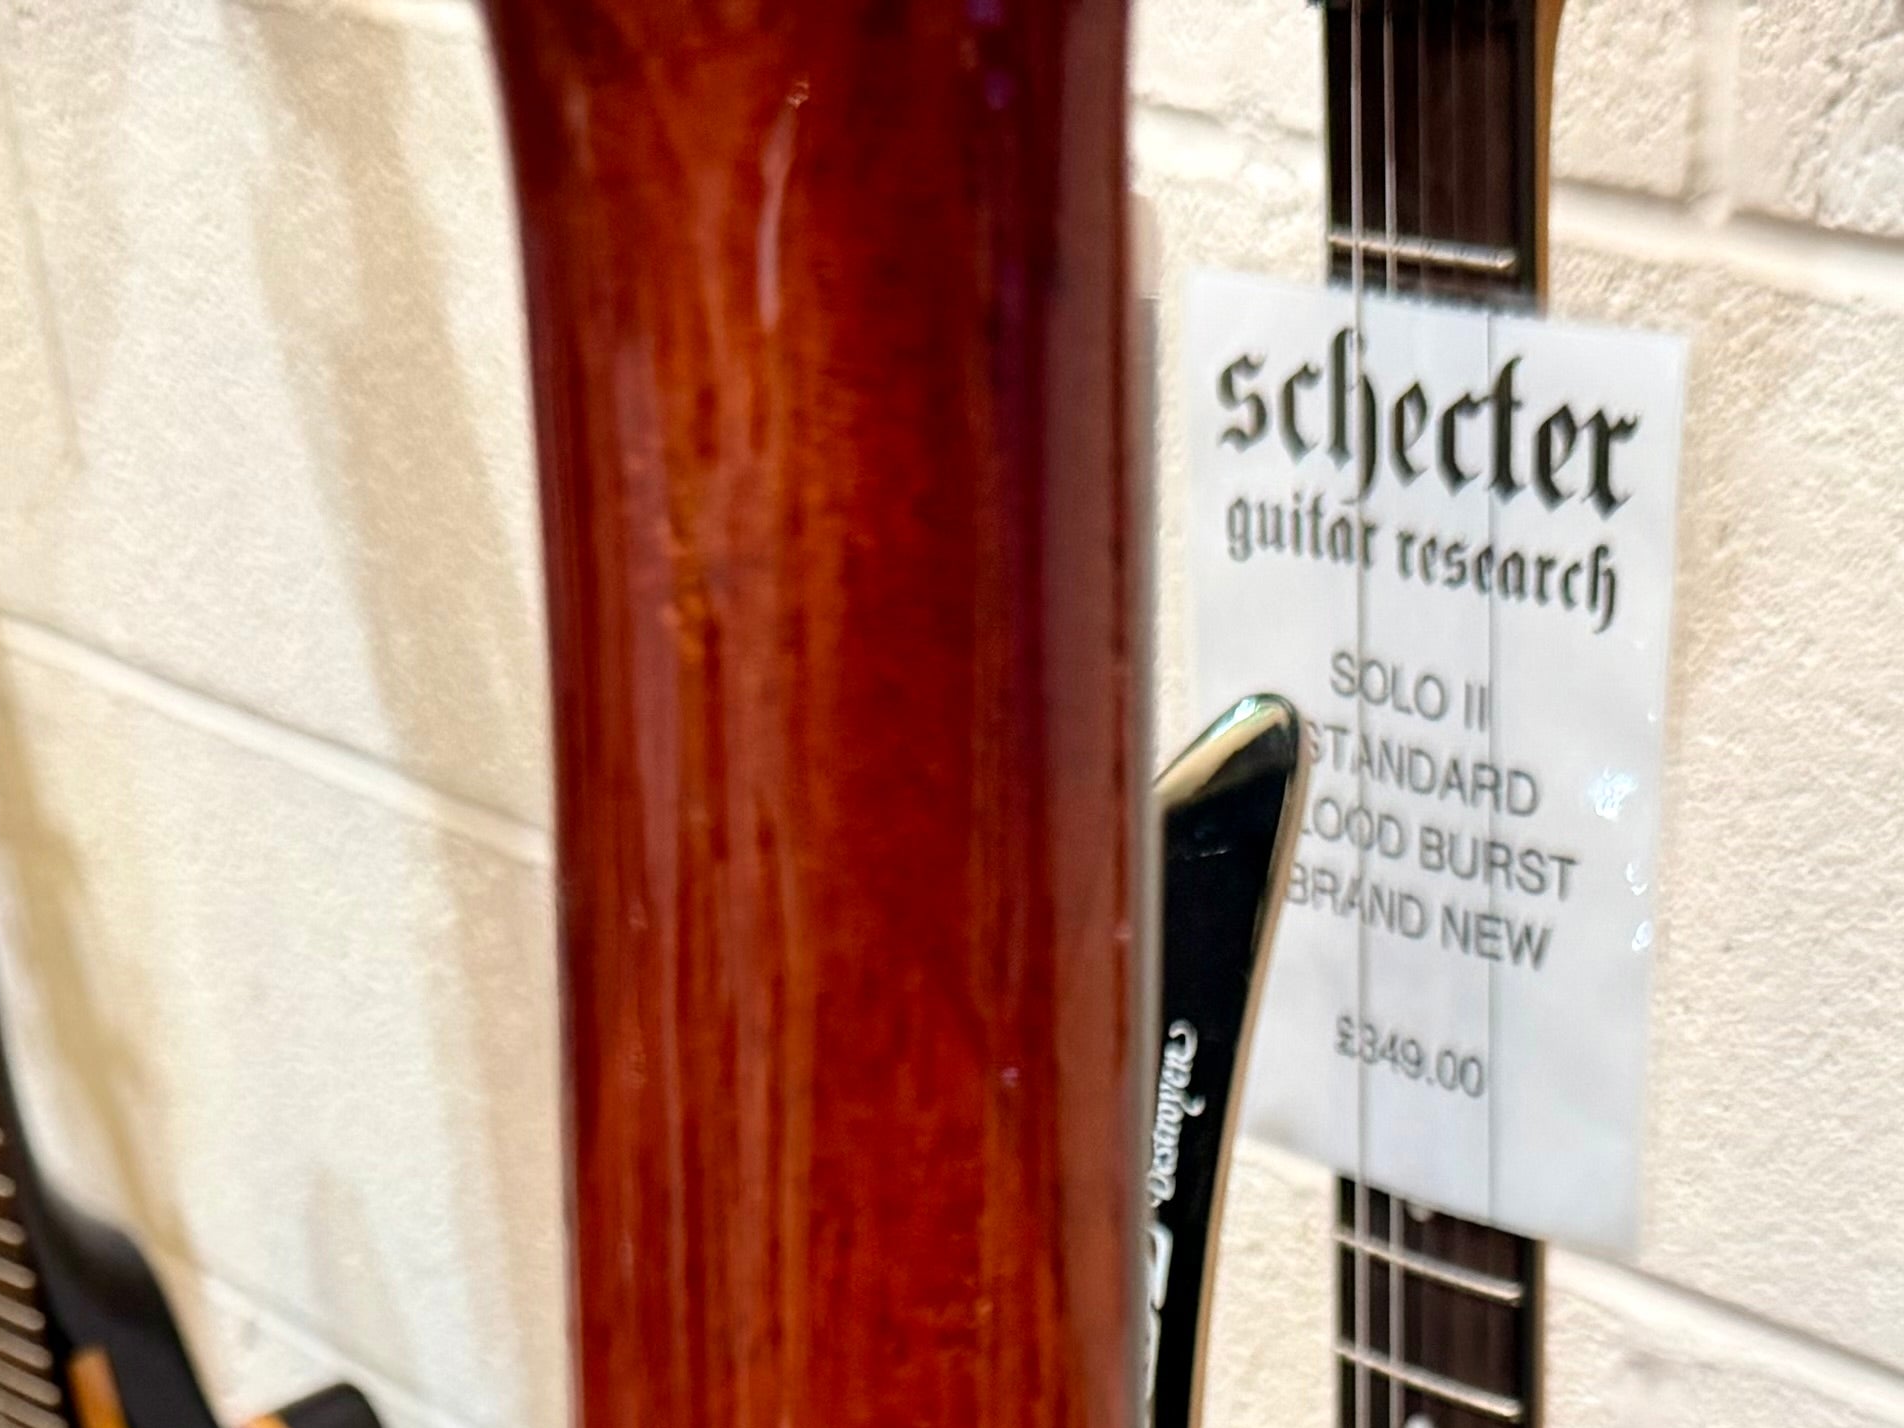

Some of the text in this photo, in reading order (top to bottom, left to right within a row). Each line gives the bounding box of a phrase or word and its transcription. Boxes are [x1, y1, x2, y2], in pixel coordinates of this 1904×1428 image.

[1217, 328, 1639, 519] schecter
[1226, 490, 1618, 634] guitar research
[1330, 650, 1487, 732] SOLO II
[1301, 719, 1539, 817] STANDARD
[1300, 797, 1580, 902] OOD BURST
[1287, 862, 1552, 972] BRAND NEW
[1334, 1013, 1486, 1099] £349.00
